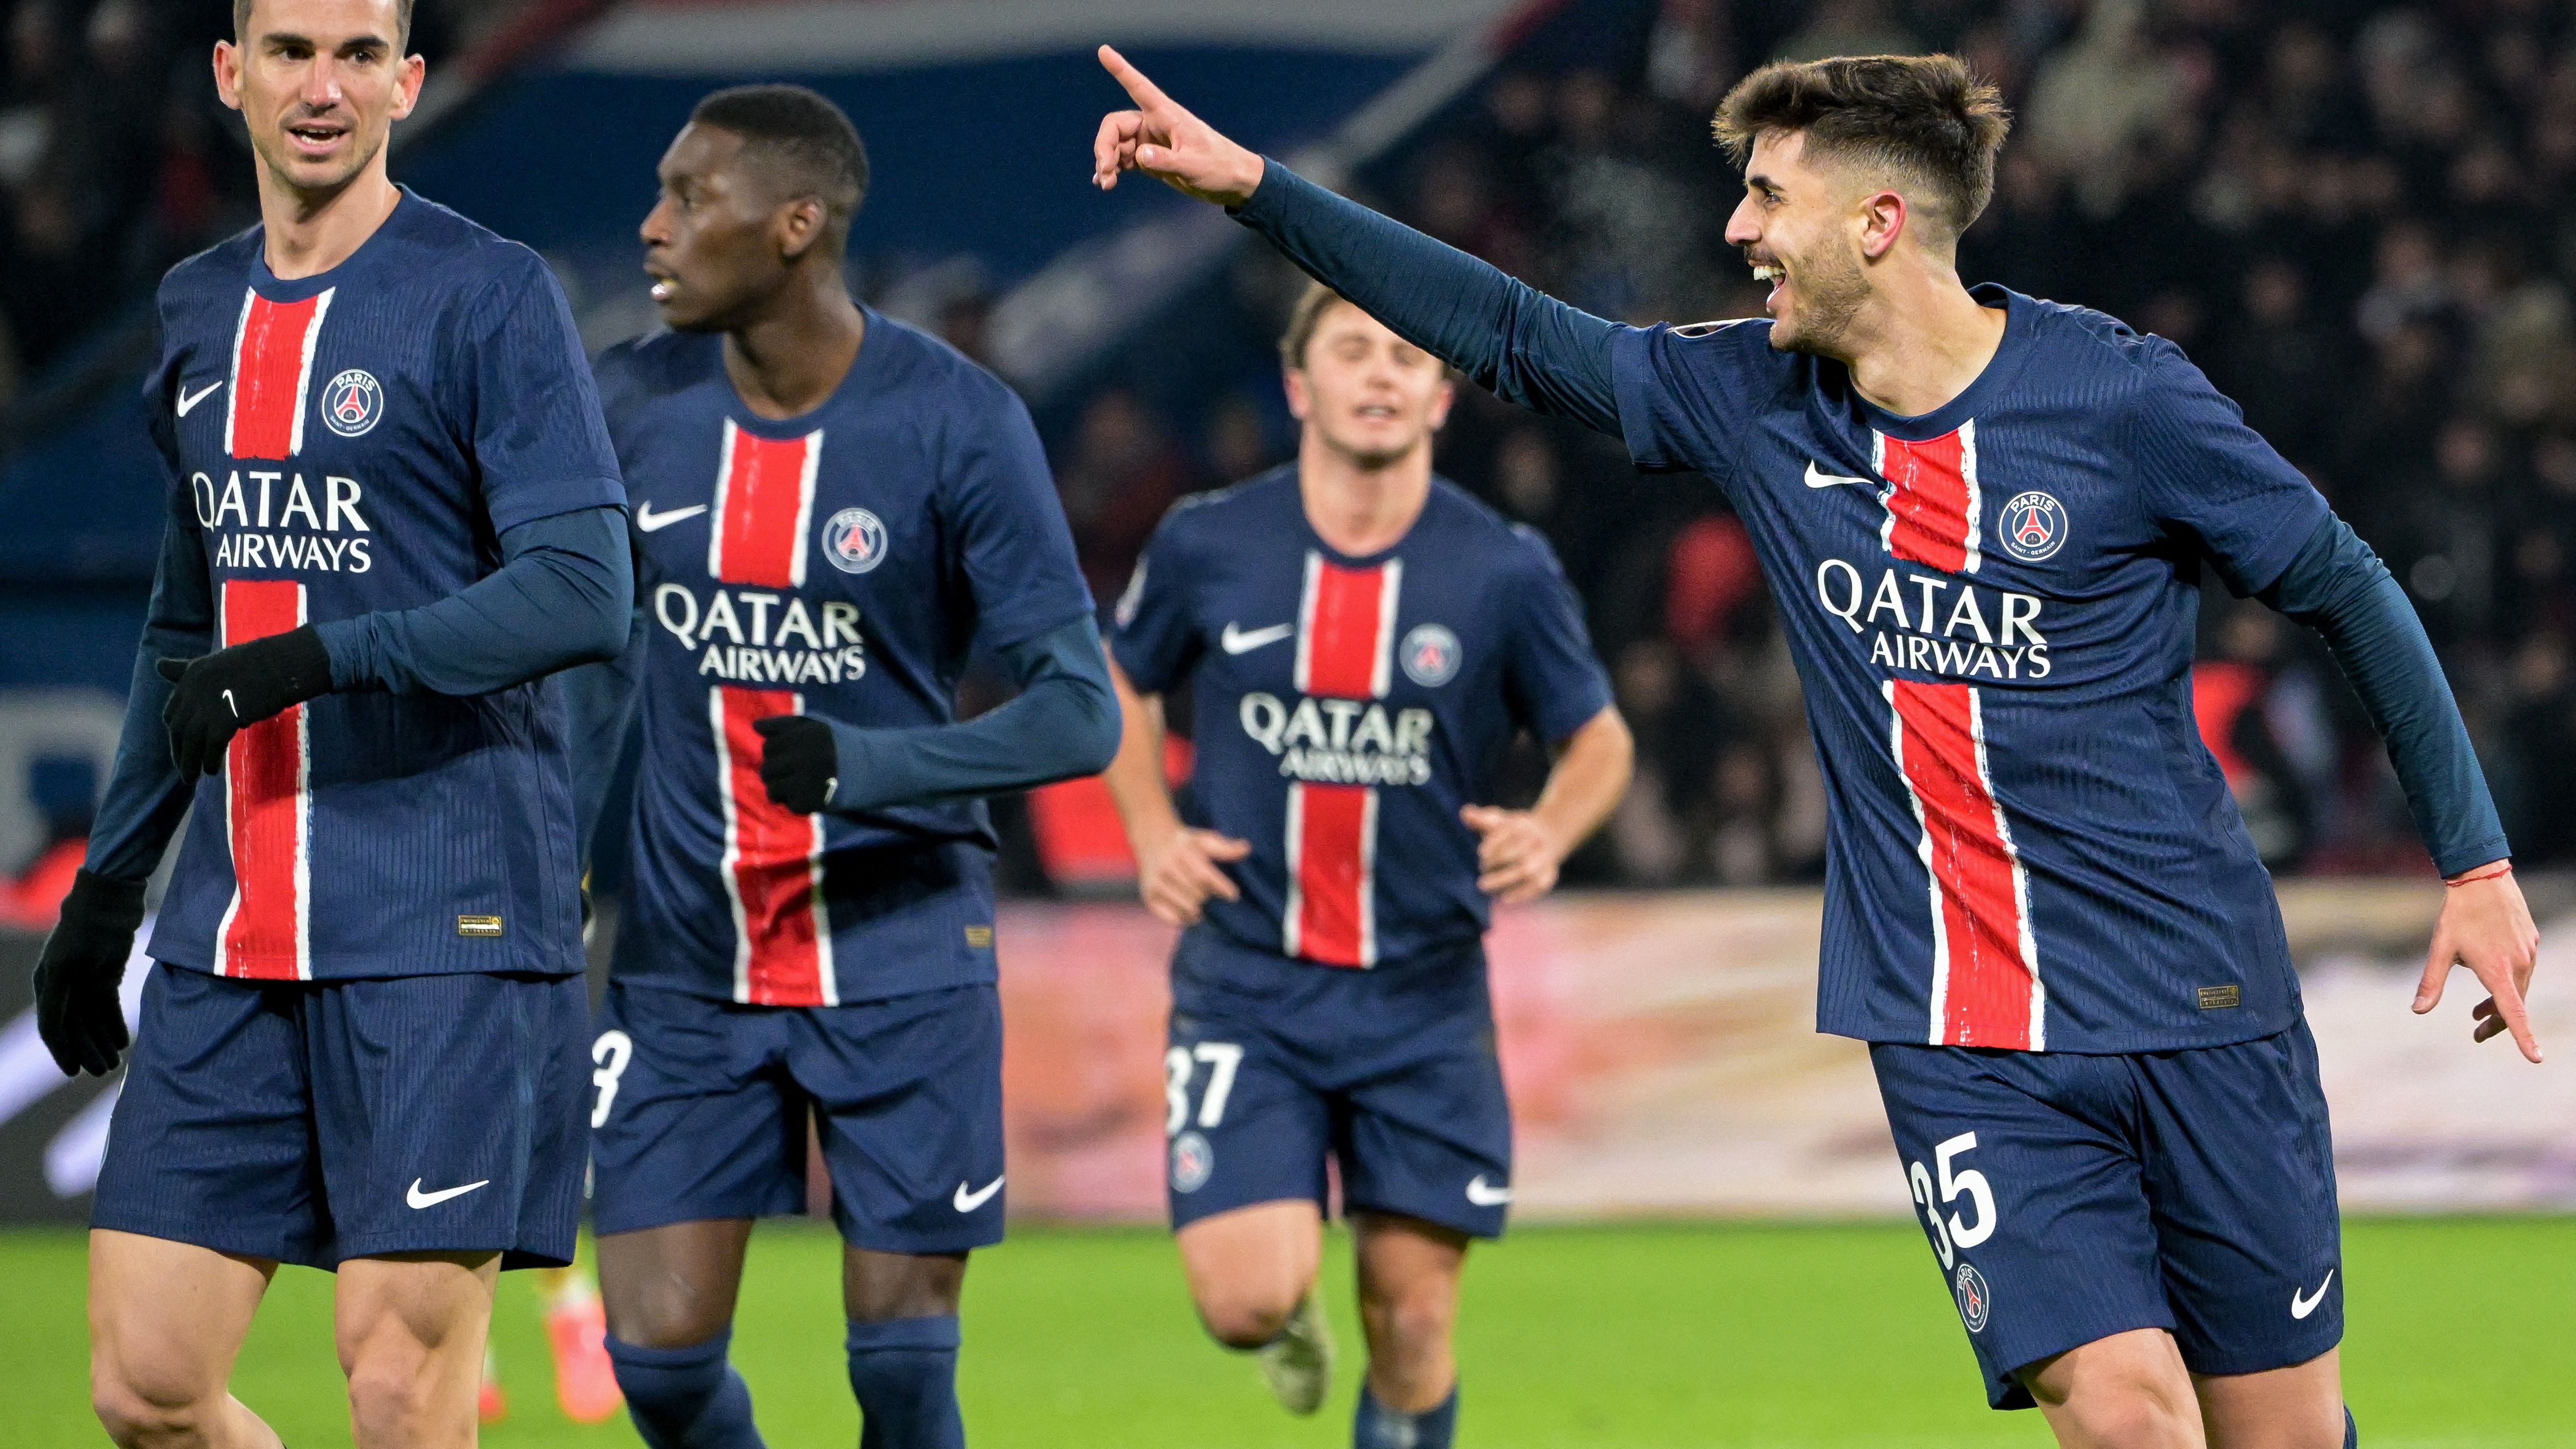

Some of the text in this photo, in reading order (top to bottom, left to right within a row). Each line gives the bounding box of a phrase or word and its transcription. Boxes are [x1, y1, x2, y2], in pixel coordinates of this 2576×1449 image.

[336, 373, 375, 391] PARIS
[193, 470, 371, 533] QATAR
[2010, 495, 2055, 513] PARIS
[216, 533, 372, 573] AIRWAYS
[654, 583, 864, 650] QATAR
[1817, 559, 2048, 646] QATAR
[698, 643, 866, 684] AIRWAYS
[1870, 631, 2051, 679] AIRWAYS
[1239, 692, 1434, 755] QATAR
[1911, 1130, 1997, 1270] 35
[1958, 1267, 1973, 1291] PARIS
